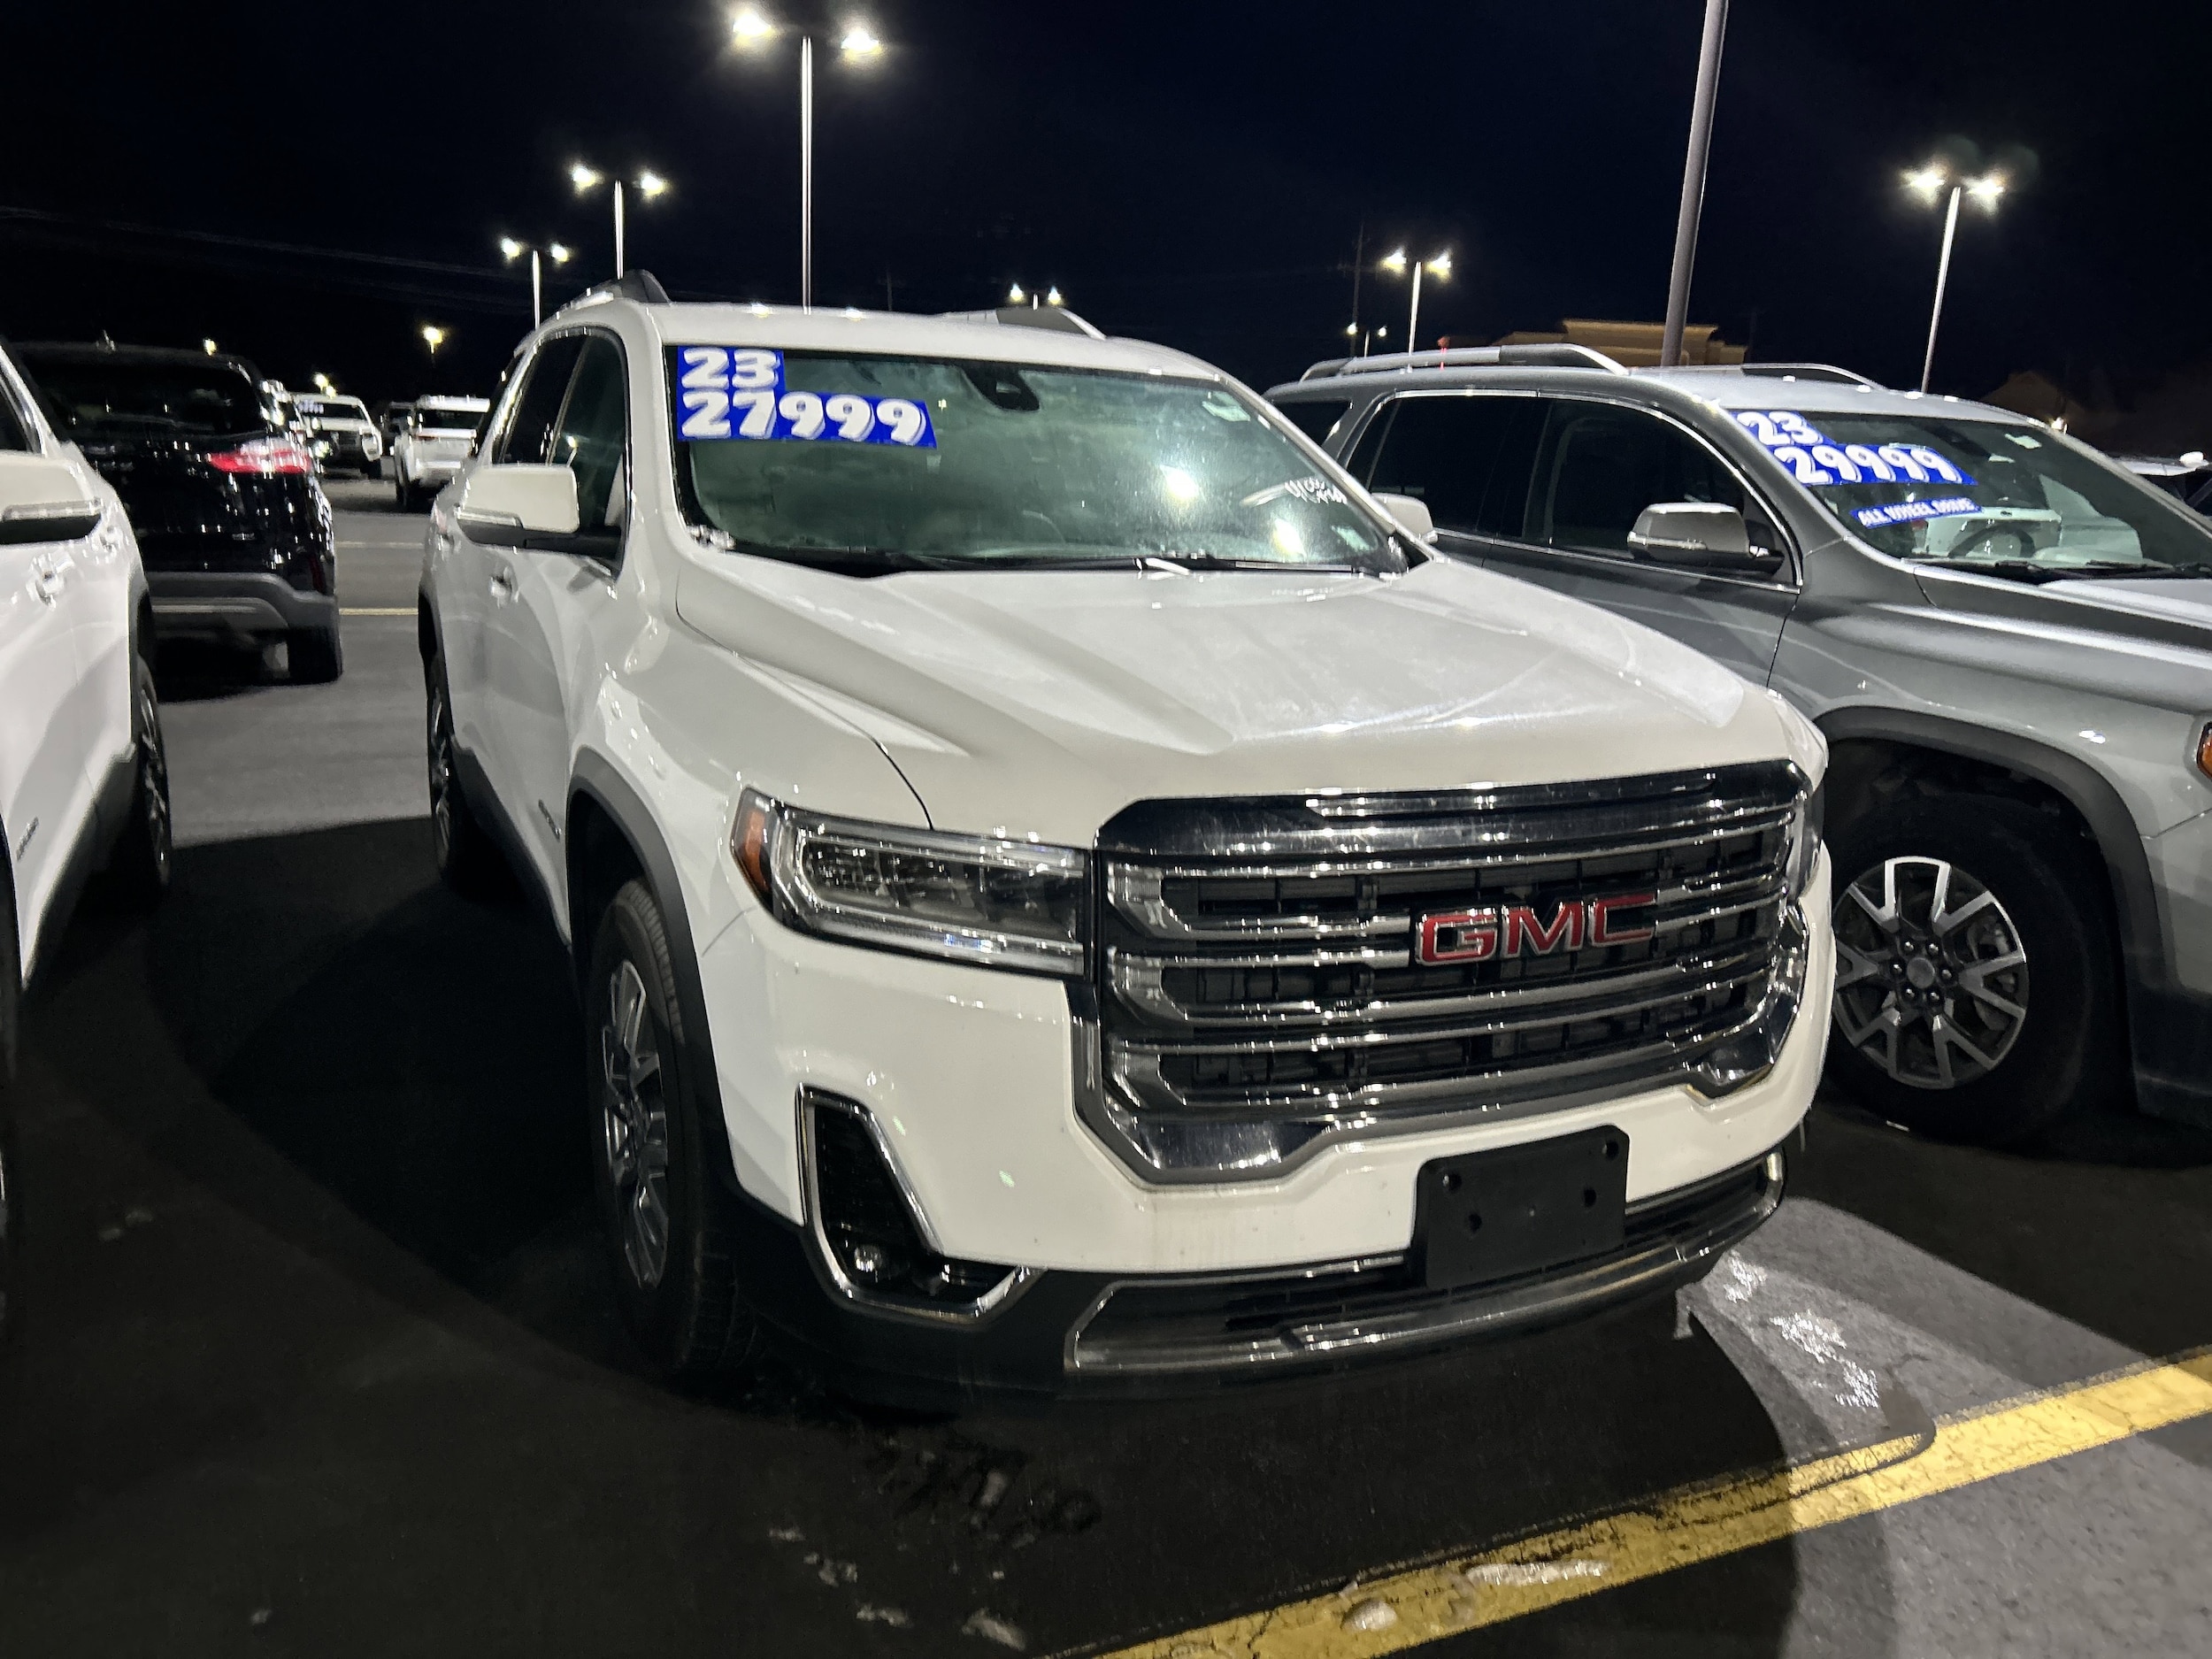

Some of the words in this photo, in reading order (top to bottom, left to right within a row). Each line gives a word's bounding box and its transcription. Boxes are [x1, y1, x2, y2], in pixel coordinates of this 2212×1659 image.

[681, 348, 780, 389] 23
[681, 390, 926, 445] 27999
[1737, 411, 1824, 445] 23
[1774, 445, 1962, 484] 29999
[1417, 891, 1656, 965] GMC
